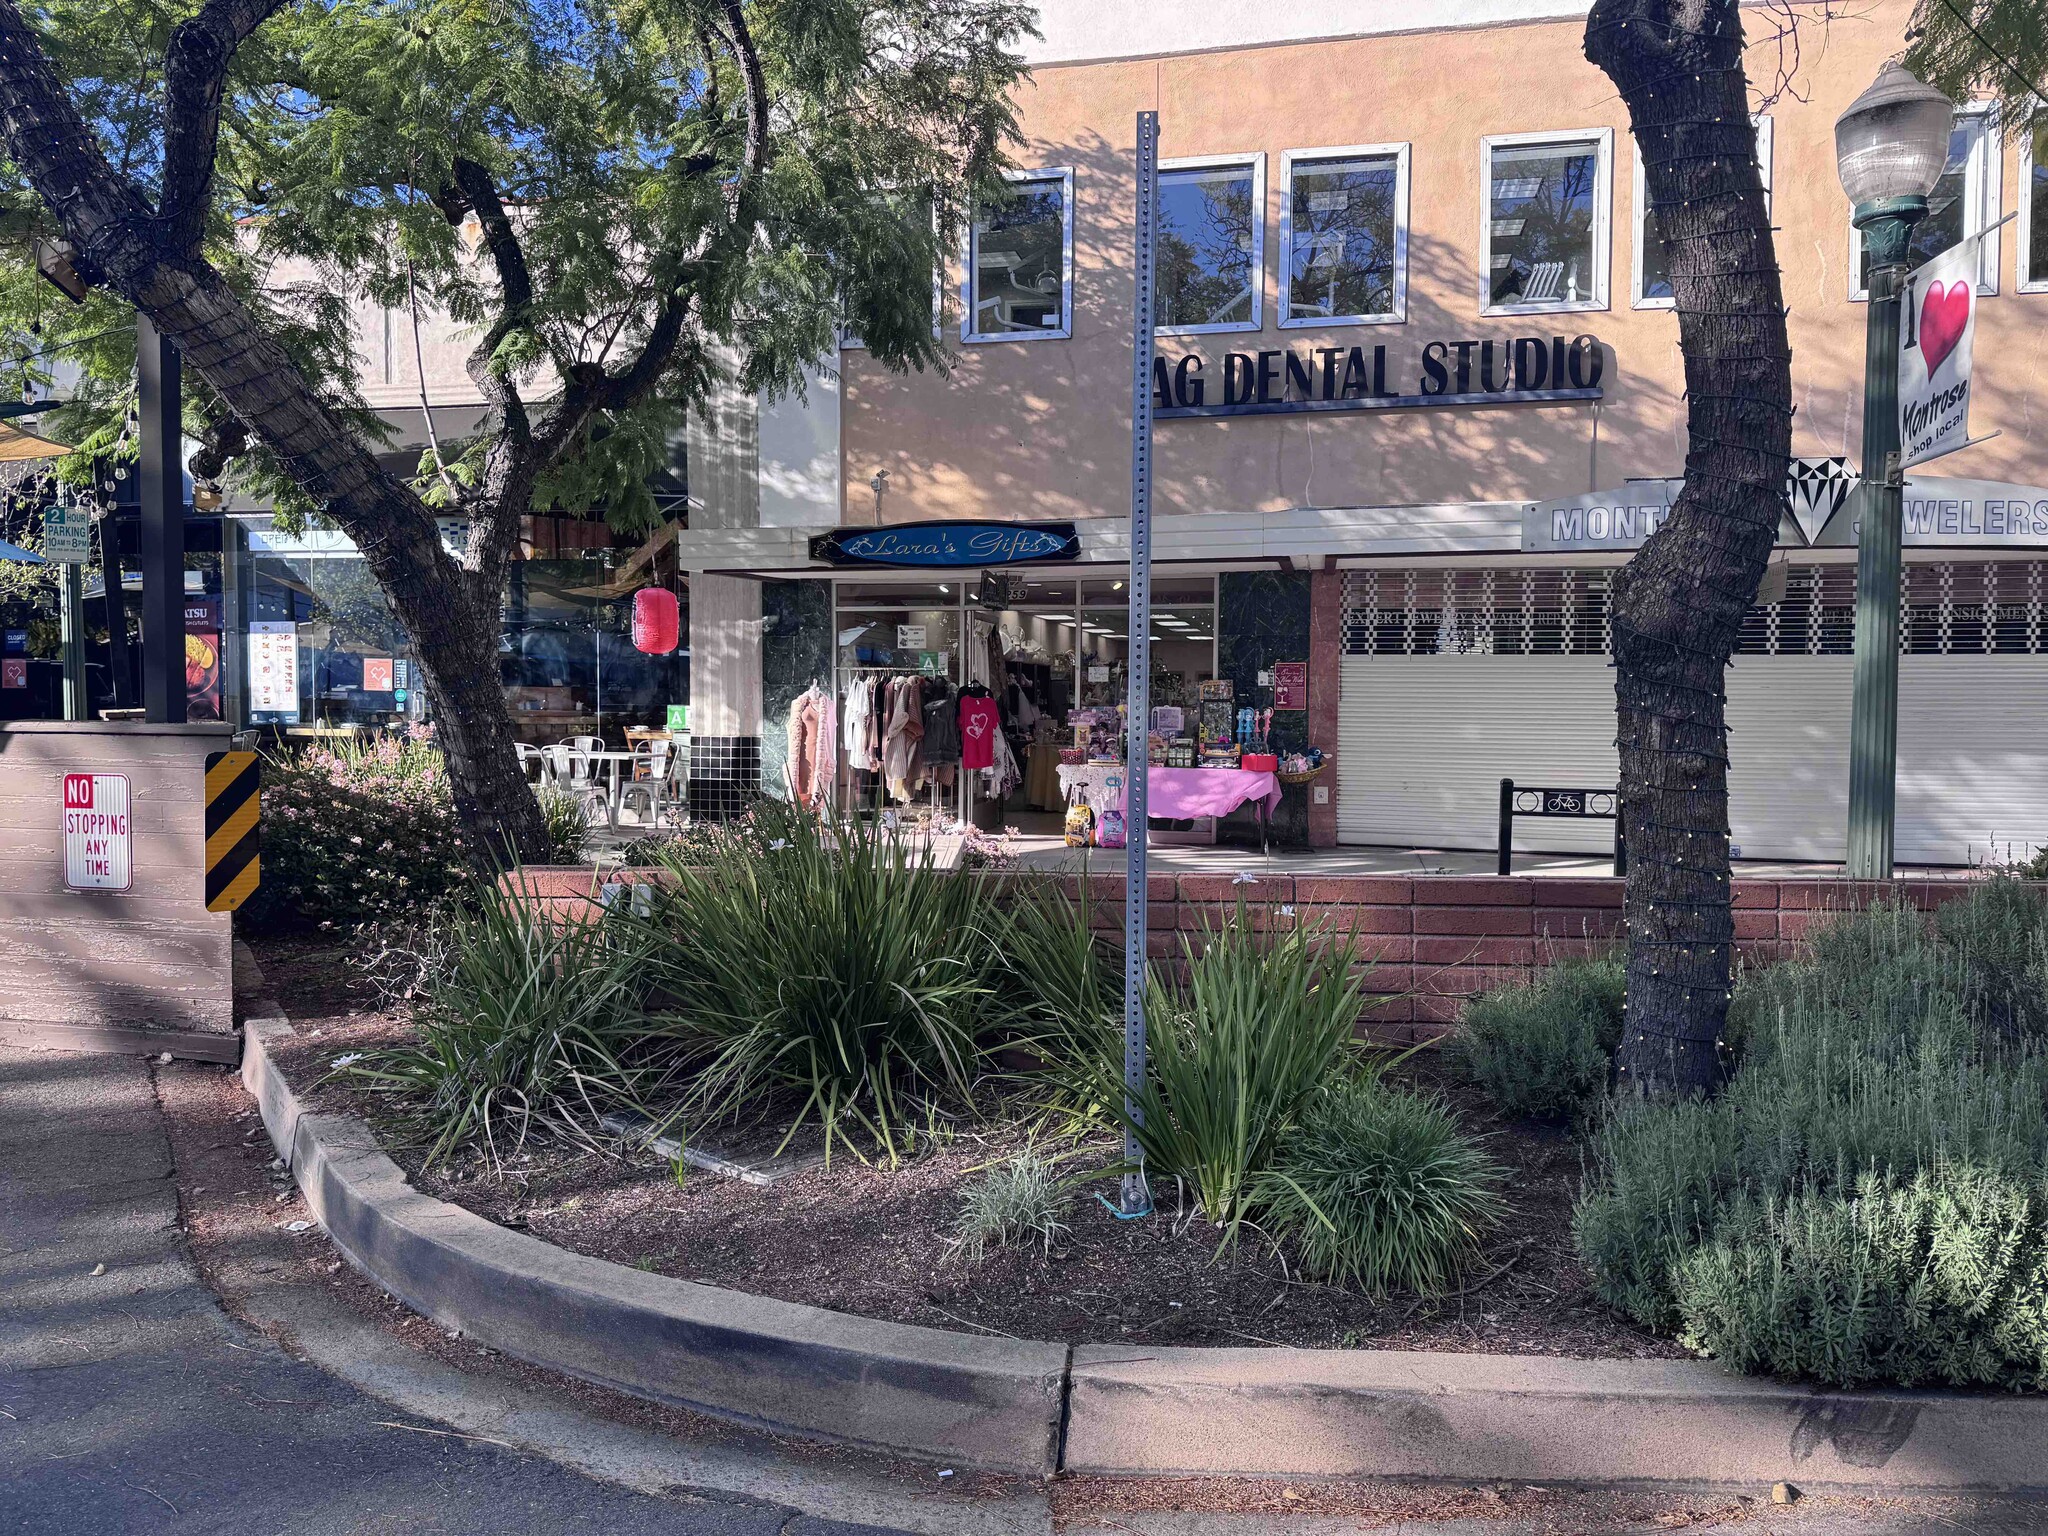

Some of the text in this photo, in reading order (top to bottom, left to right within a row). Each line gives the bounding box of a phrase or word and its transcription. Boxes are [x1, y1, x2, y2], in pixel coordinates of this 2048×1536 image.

[1904, 275, 1918, 350] I
[1224, 345, 1400, 406] DENTAL
[1420, 333, 1604, 396] STUDIO
[1902, 379, 1968, 447] Montrose
[1907, 408, 1964, 461] shop local
[50, 508, 86, 524] 2 HOUR
[48, 525, 86, 538] PARKING
[863, 531, 1042, 561] Lara's Gifts
[923, 656, 935, 670] A
[671, 710, 683, 724] A
[68, 779, 90, 804] NO
[67, 813, 126, 836] STOPPING
[86, 840, 108, 856] ANY
[85, 860, 110, 876] TIME
